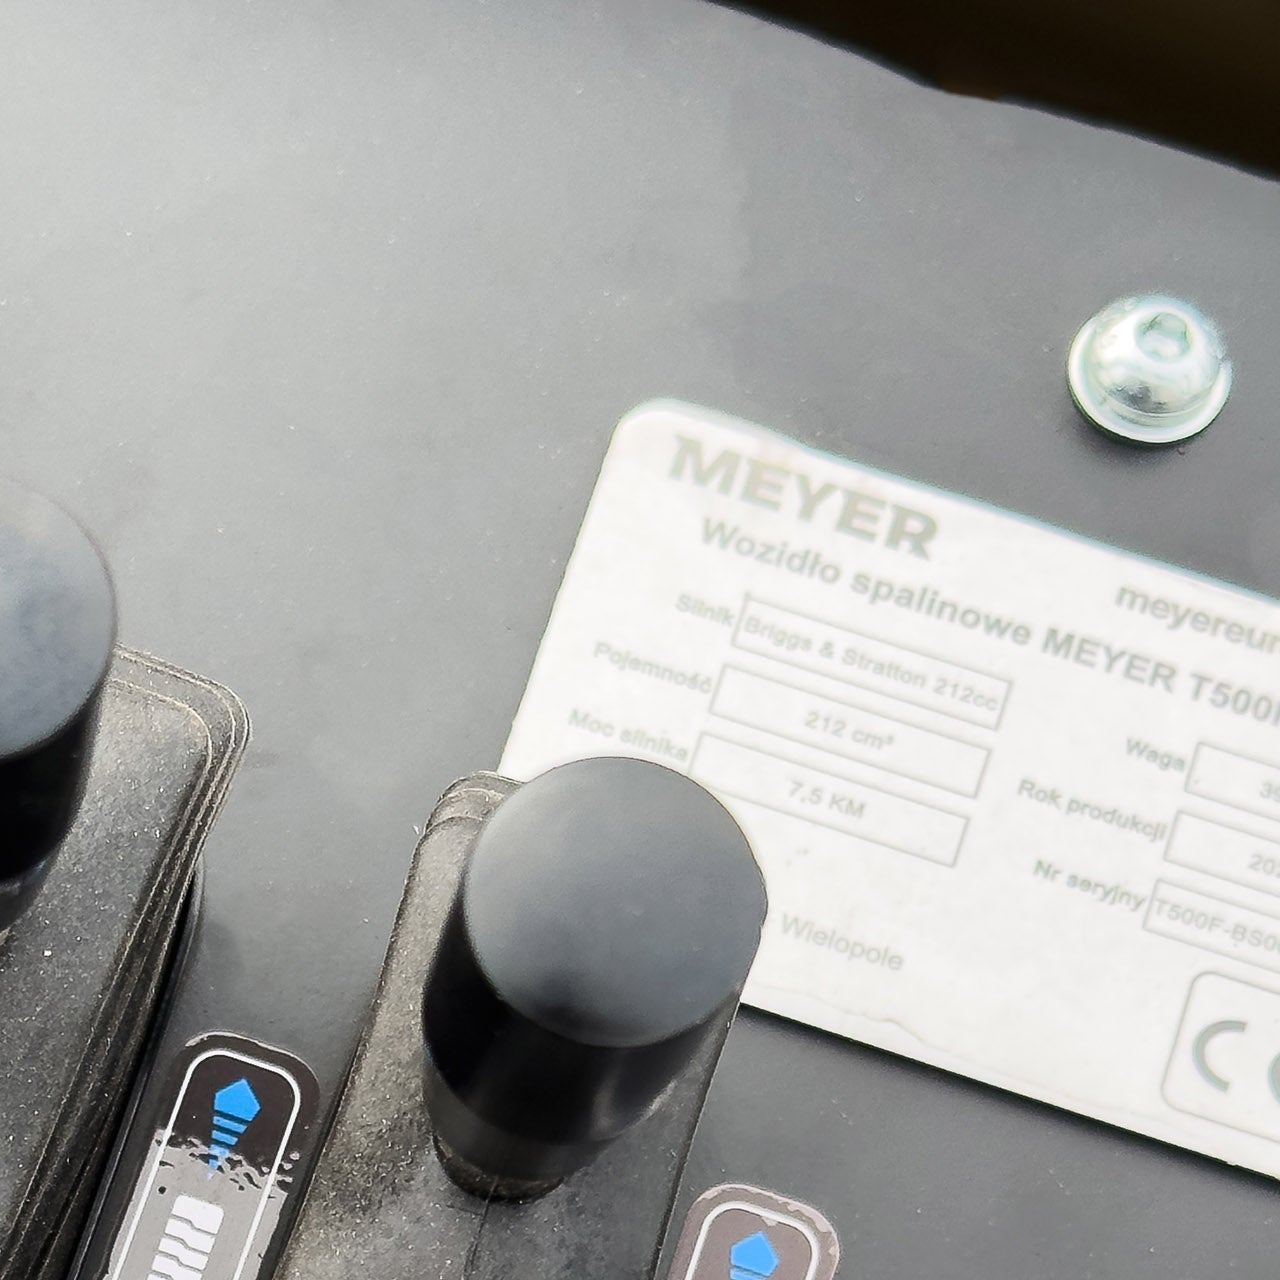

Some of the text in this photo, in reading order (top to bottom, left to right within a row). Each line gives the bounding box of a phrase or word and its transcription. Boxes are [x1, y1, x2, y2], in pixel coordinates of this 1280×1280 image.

[667, 433, 940, 560] MEYER
[675, 593, 734, 629] Silnik
[701, 517, 840, 585] Wozidło
[851, 570, 1031, 645] spalinowe
[1041, 627, 1176, 694] MEYER
[593, 641, 713, 697] Pojemność
[744, 615, 1001, 712] Briggs & Stratton 212cc
[567, 708, 690, 762] Moc silnika
[803, 709, 846, 736] 212
[1125, 737, 1187, 776] Waga
[827, 790, 867, 820] KM
[1017, 778, 1168, 844] Rok produkcji
[1033, 860, 1146, 913] Nr seryjny
[780, 913, 905, 970] Wielopole
